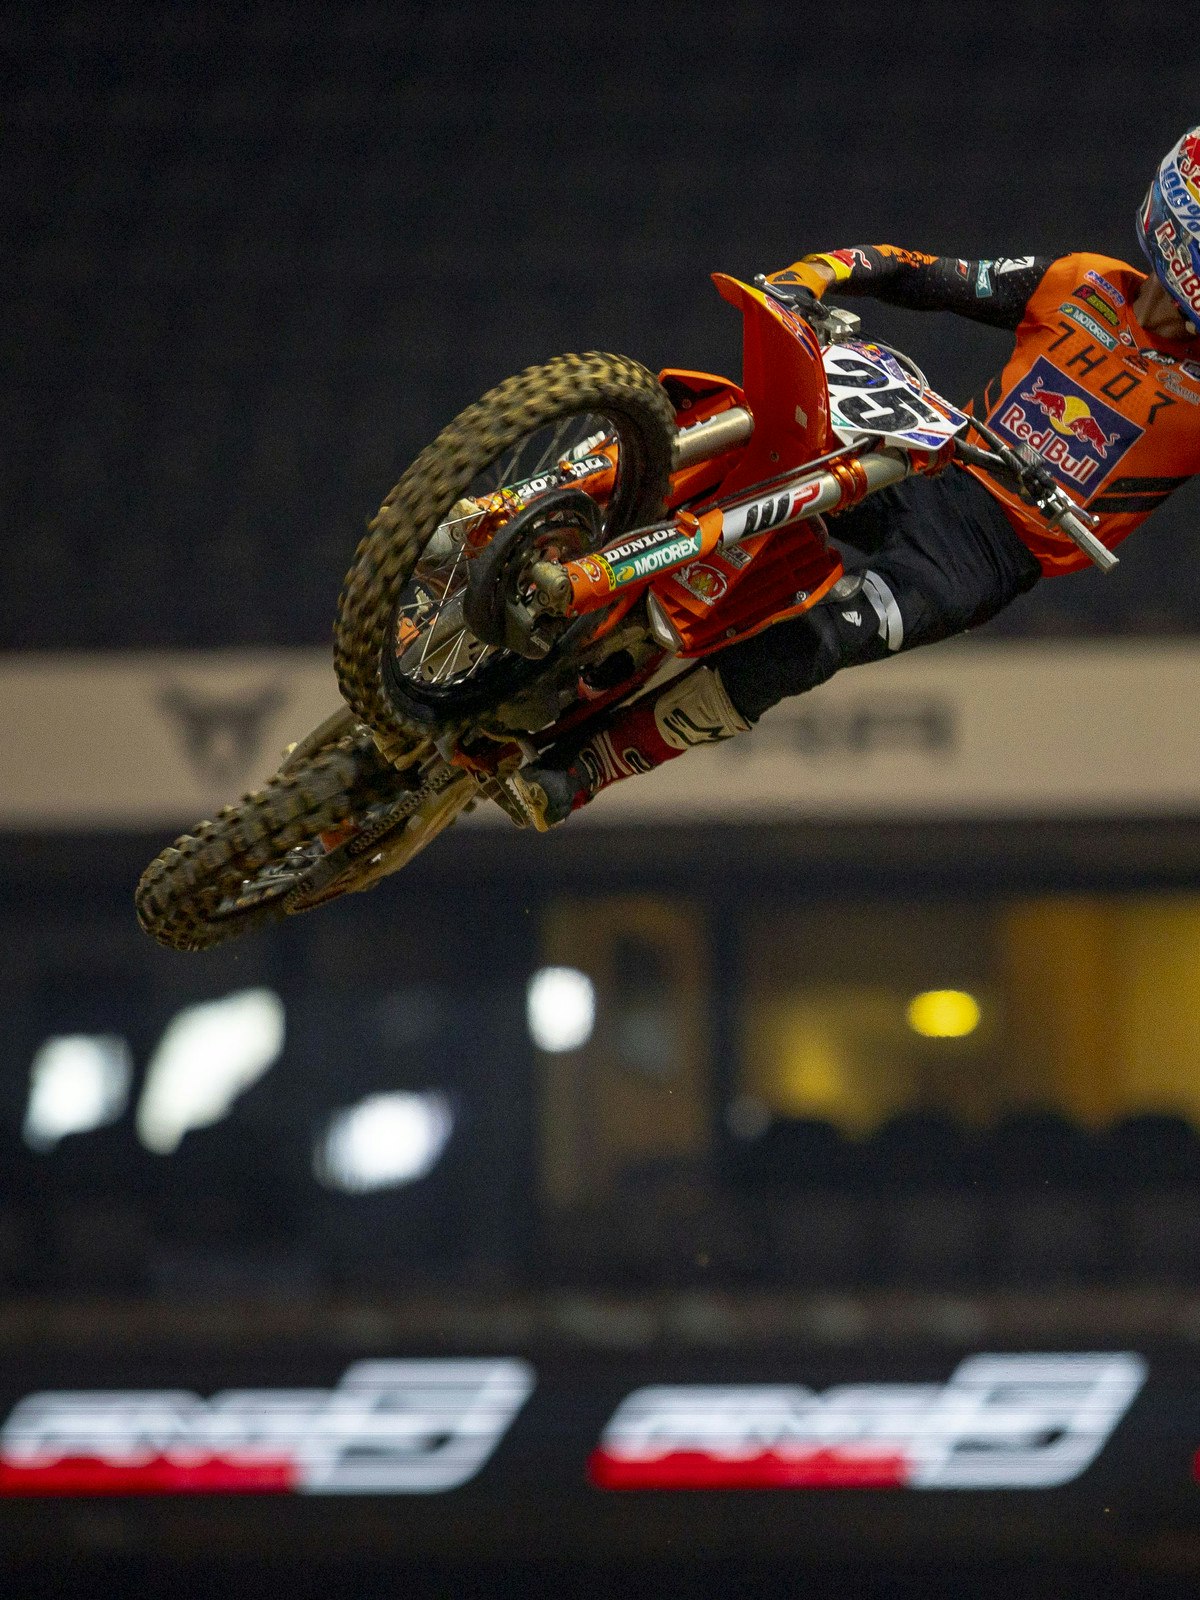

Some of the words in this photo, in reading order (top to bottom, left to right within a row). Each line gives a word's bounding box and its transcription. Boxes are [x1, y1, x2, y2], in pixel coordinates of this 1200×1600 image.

[1072, 310, 1115, 347] MOTOREX
[1000, 403, 1045, 450] Red
[1043, 436, 1100, 486] Bull
[633, 537, 699, 577] MOTOREX
